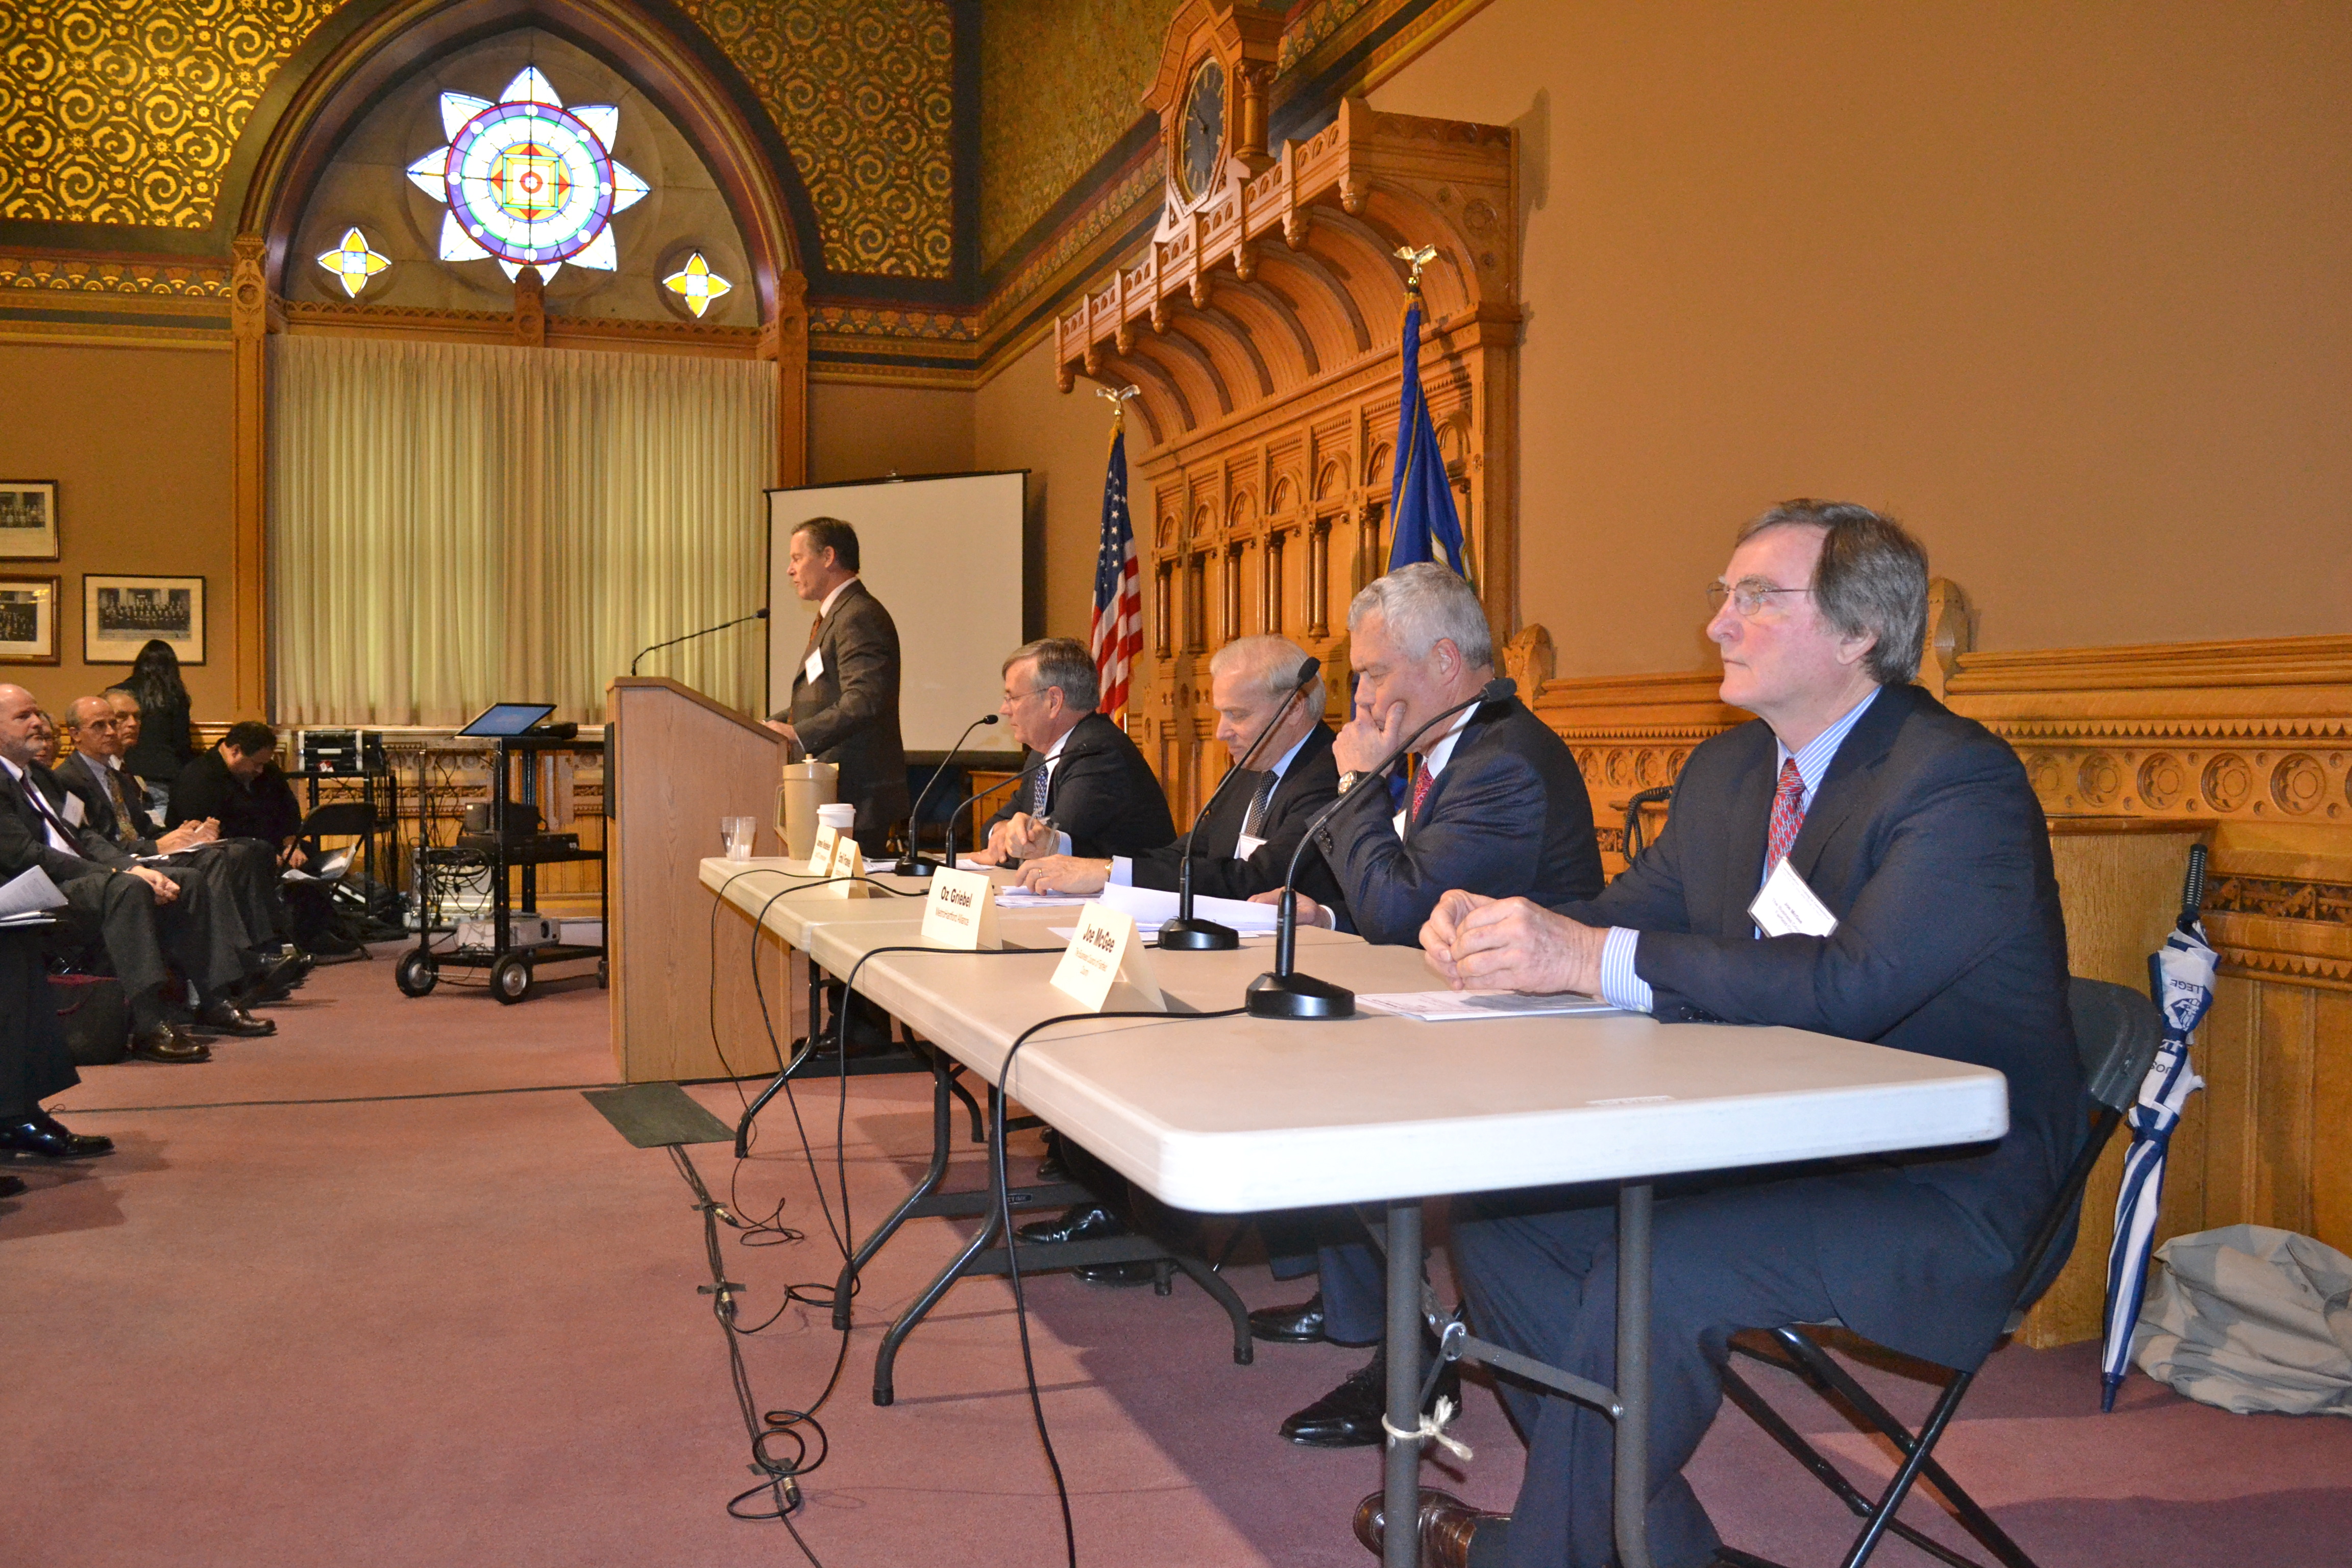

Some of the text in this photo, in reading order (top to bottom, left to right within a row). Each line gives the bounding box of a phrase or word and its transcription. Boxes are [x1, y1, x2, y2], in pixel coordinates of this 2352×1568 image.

[941, 886, 973, 908] Oz Griebel
[1083, 924, 1115, 953] Joe McGee
